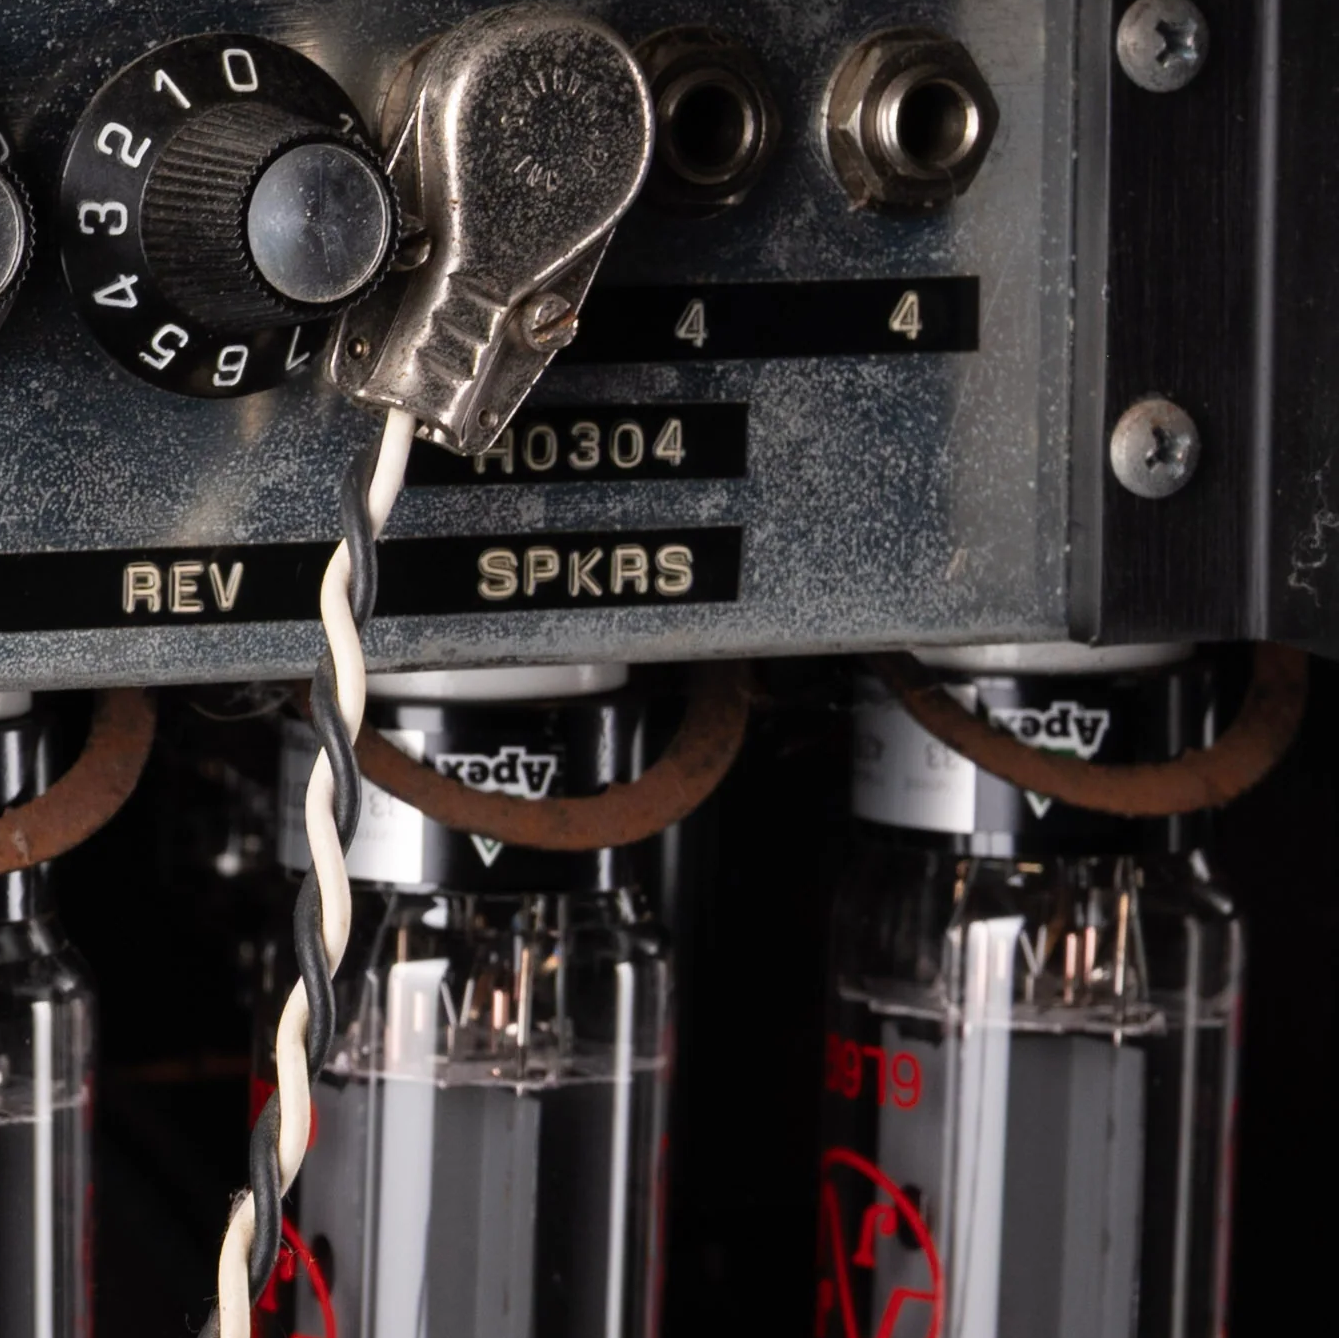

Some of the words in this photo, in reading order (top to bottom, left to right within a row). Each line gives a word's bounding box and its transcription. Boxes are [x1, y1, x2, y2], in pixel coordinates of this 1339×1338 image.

[153, 68, 192, 110] 1
[222, 47, 260, 93] 0
[95, 121, 153, 169] 2
[77, 200, 129, 237] 3
[92, 272, 139, 309] 4
[674, 297, 709, 349] 4
[887, 288, 923, 341] 4
[138, 322, 190, 371] 5
[211, 344, 249, 388] 6
[122, 560, 245, 615] REV
[476, 545, 697, 602] SPKRS
